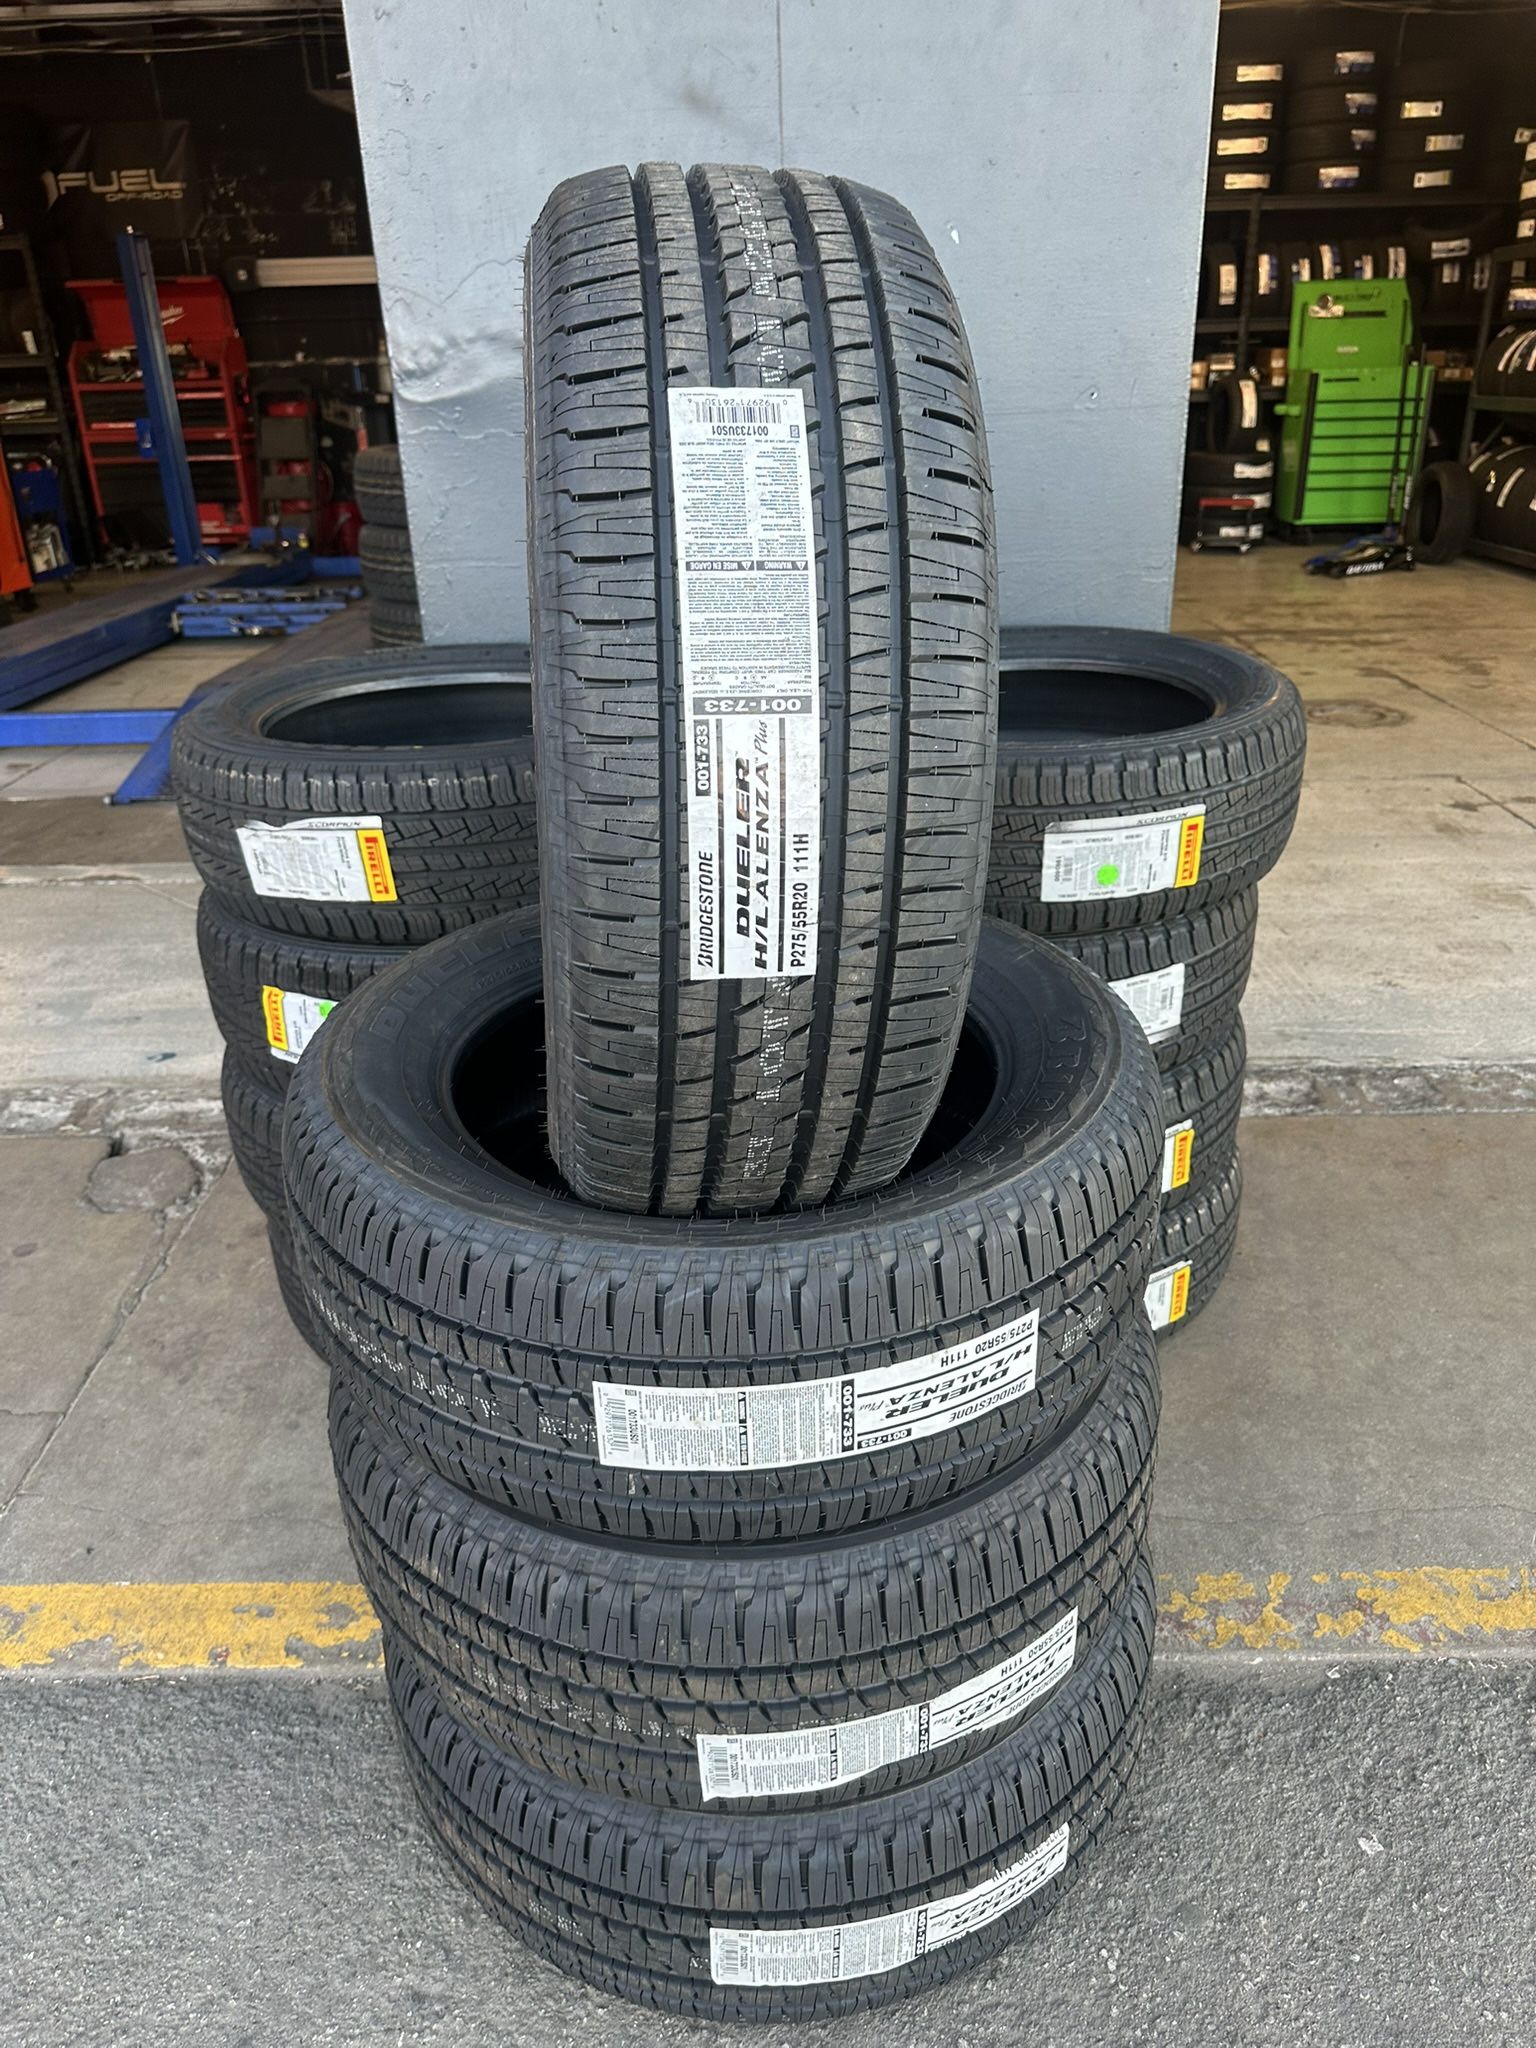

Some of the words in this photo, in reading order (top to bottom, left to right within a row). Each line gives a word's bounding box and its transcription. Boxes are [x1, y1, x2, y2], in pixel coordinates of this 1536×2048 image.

[57, 168, 187, 195] FUEL
[711, 425, 769, 436] 001733US01
[704, 699, 802, 713] 001-733
[755, 719, 768, 756] Plus
[695, 725, 710, 791] 001-733
[735, 757, 750, 938] DUELER
[755, 762, 769, 902] ALENZA
[1181, 823, 1199, 881] PIRELLI
[364, 836, 390, 895] PIRELLI
[793, 833, 809, 873] 111H
[697, 850, 714, 968] BRIDGESTONE
[790, 882, 809, 968] P275/55R20
[754, 905, 769, 970] H/L
[974, 1319, 1033, 1355] P275/55R20
[990, 1343, 1033, 1366] H/L
[941, 1350, 968, 1368] 111H
[858, 1400, 885, 1412] Plus
[885, 1366, 1010, 1419] DUELER
[889, 1366, 986, 1406] ALENZA
[949, 1379, 1027, 1423] BRIDGESTONE
[843, 1385, 853, 1447] 001-733
[861, 1430, 908, 1448] 001-733
[1001, 1657, 1023, 1677] 111H
